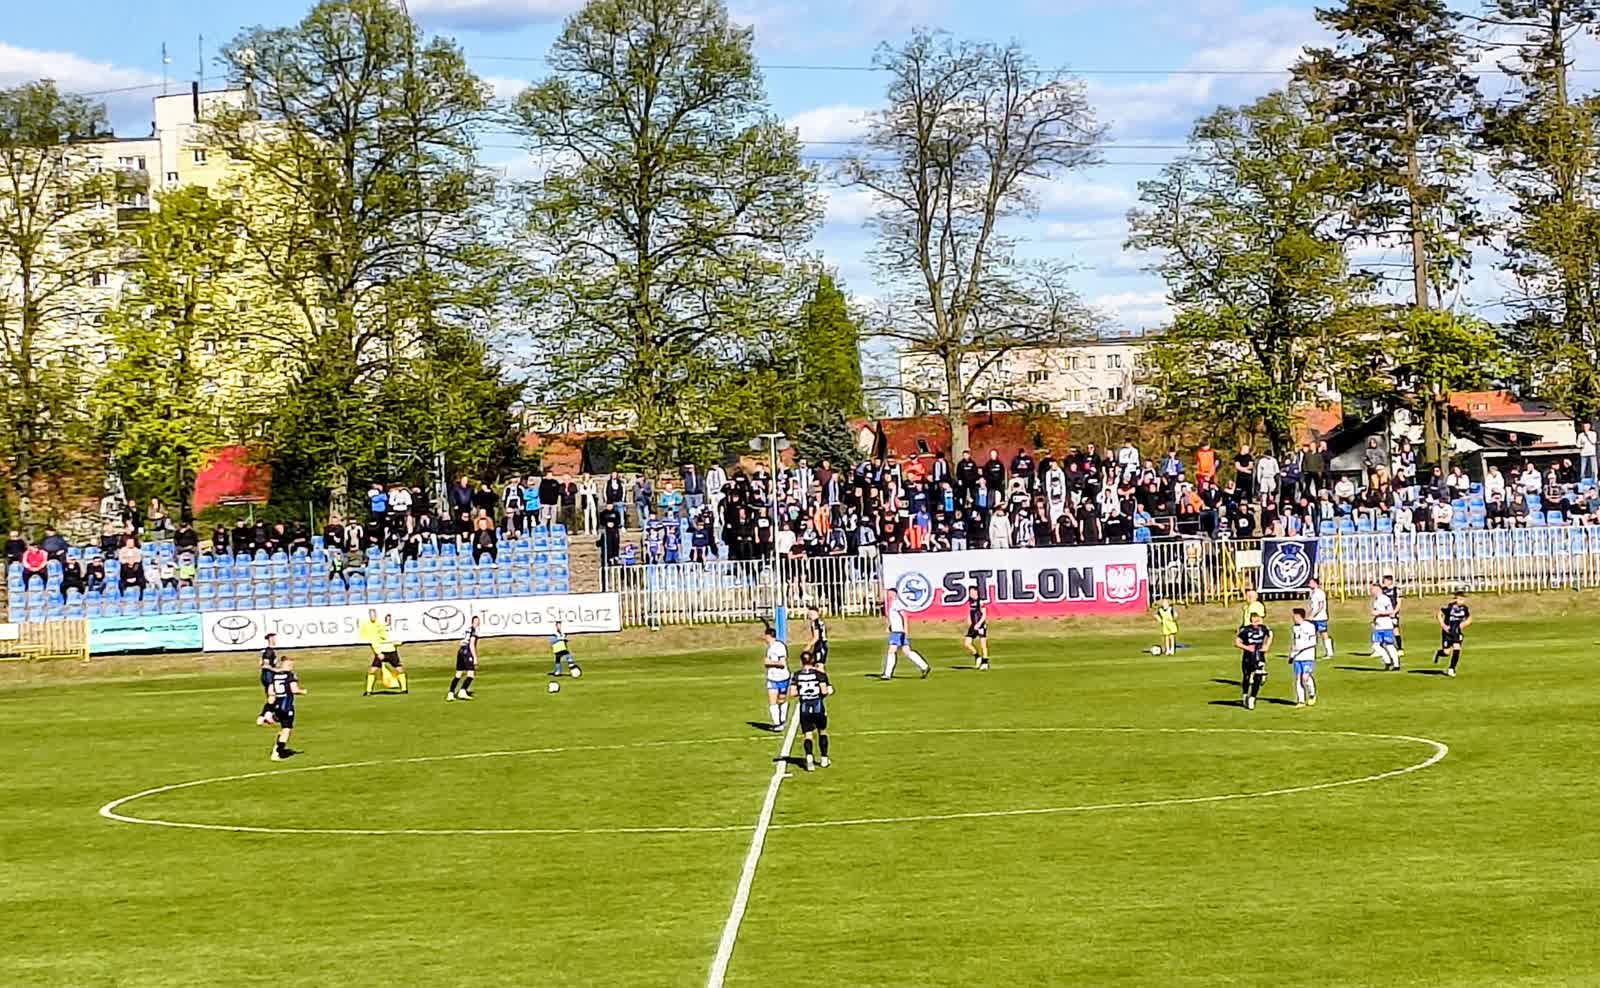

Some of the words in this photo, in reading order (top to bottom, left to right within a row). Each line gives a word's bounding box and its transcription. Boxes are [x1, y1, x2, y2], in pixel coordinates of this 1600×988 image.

[942, 566, 1095, 604] STILON
[272, 618, 339, 639] Toyota
[480, 609, 542, 630] Toyota
[546, 604, 612, 624] Stolarz
[798, 680, 820, 696] 25
